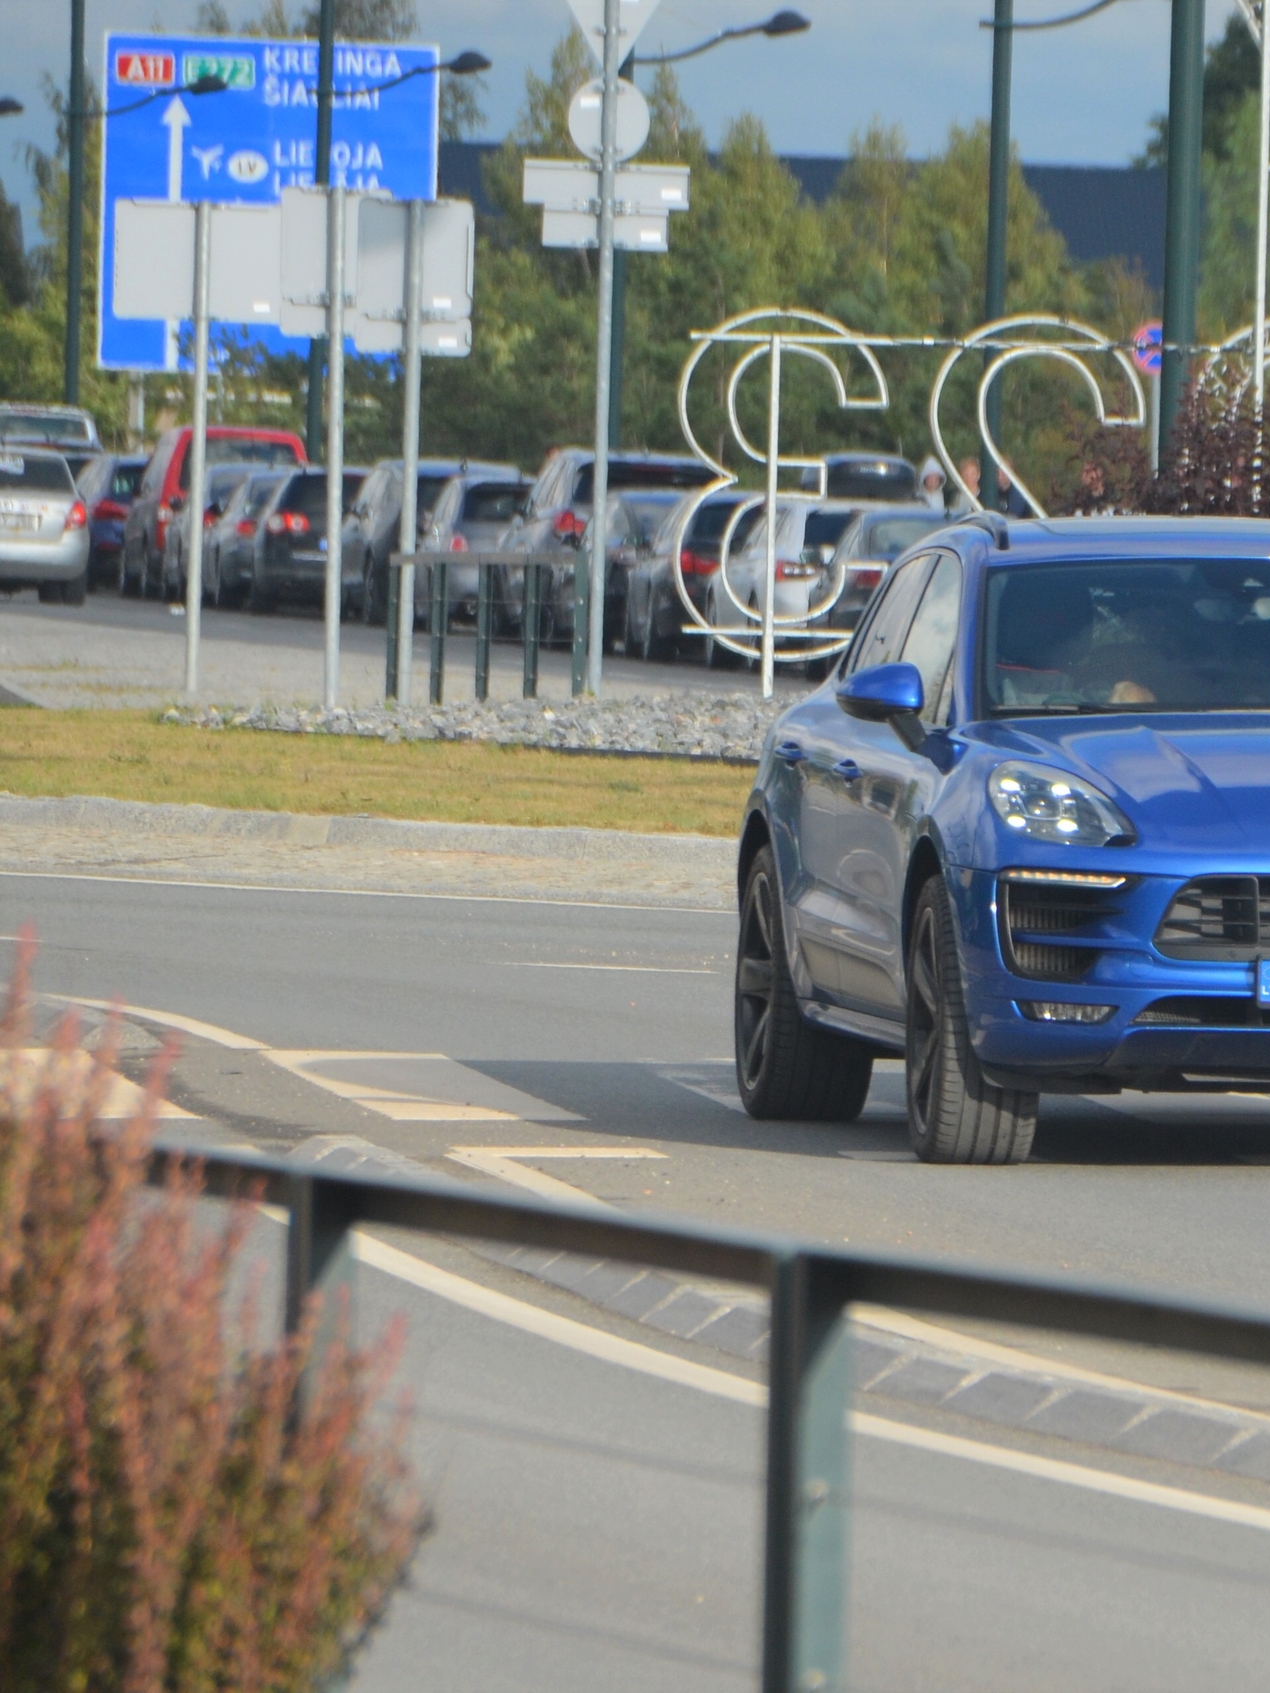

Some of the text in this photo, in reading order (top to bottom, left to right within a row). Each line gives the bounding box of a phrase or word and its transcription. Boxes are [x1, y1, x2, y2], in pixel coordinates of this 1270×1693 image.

[126, 54, 165, 81] A11
[264, 47, 402, 78] KREINGA
[273, 139, 384, 171] LIEOJA
